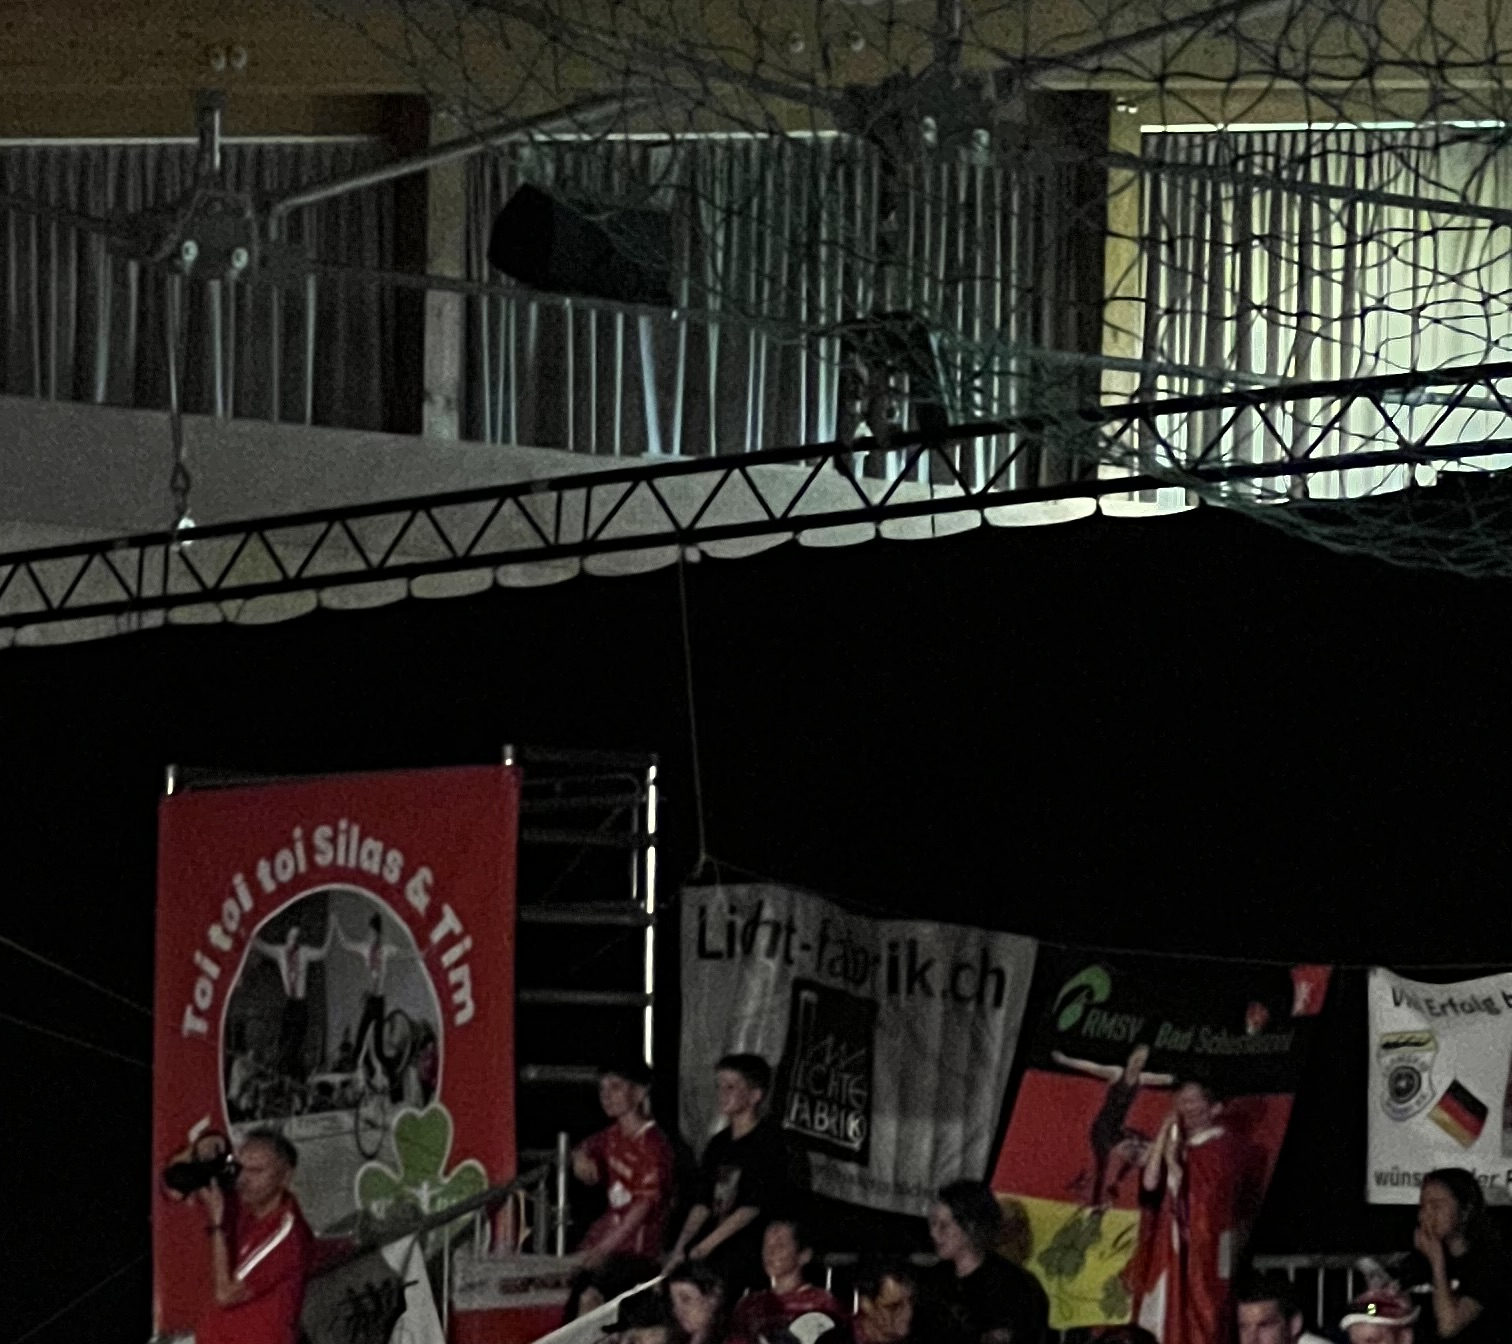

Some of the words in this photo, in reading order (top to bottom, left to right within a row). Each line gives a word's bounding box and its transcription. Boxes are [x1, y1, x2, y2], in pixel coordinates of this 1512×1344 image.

[182, 951, 221, 1039] Toi
[207, 873, 253, 951] toi
[257, 828, 307, 893] toi
[313, 819, 404, 883] Silas
[405, 867, 434, 916] &
[429, 904, 475, 1027] Tim
[1424, 995, 1501, 1017] Erfolg
